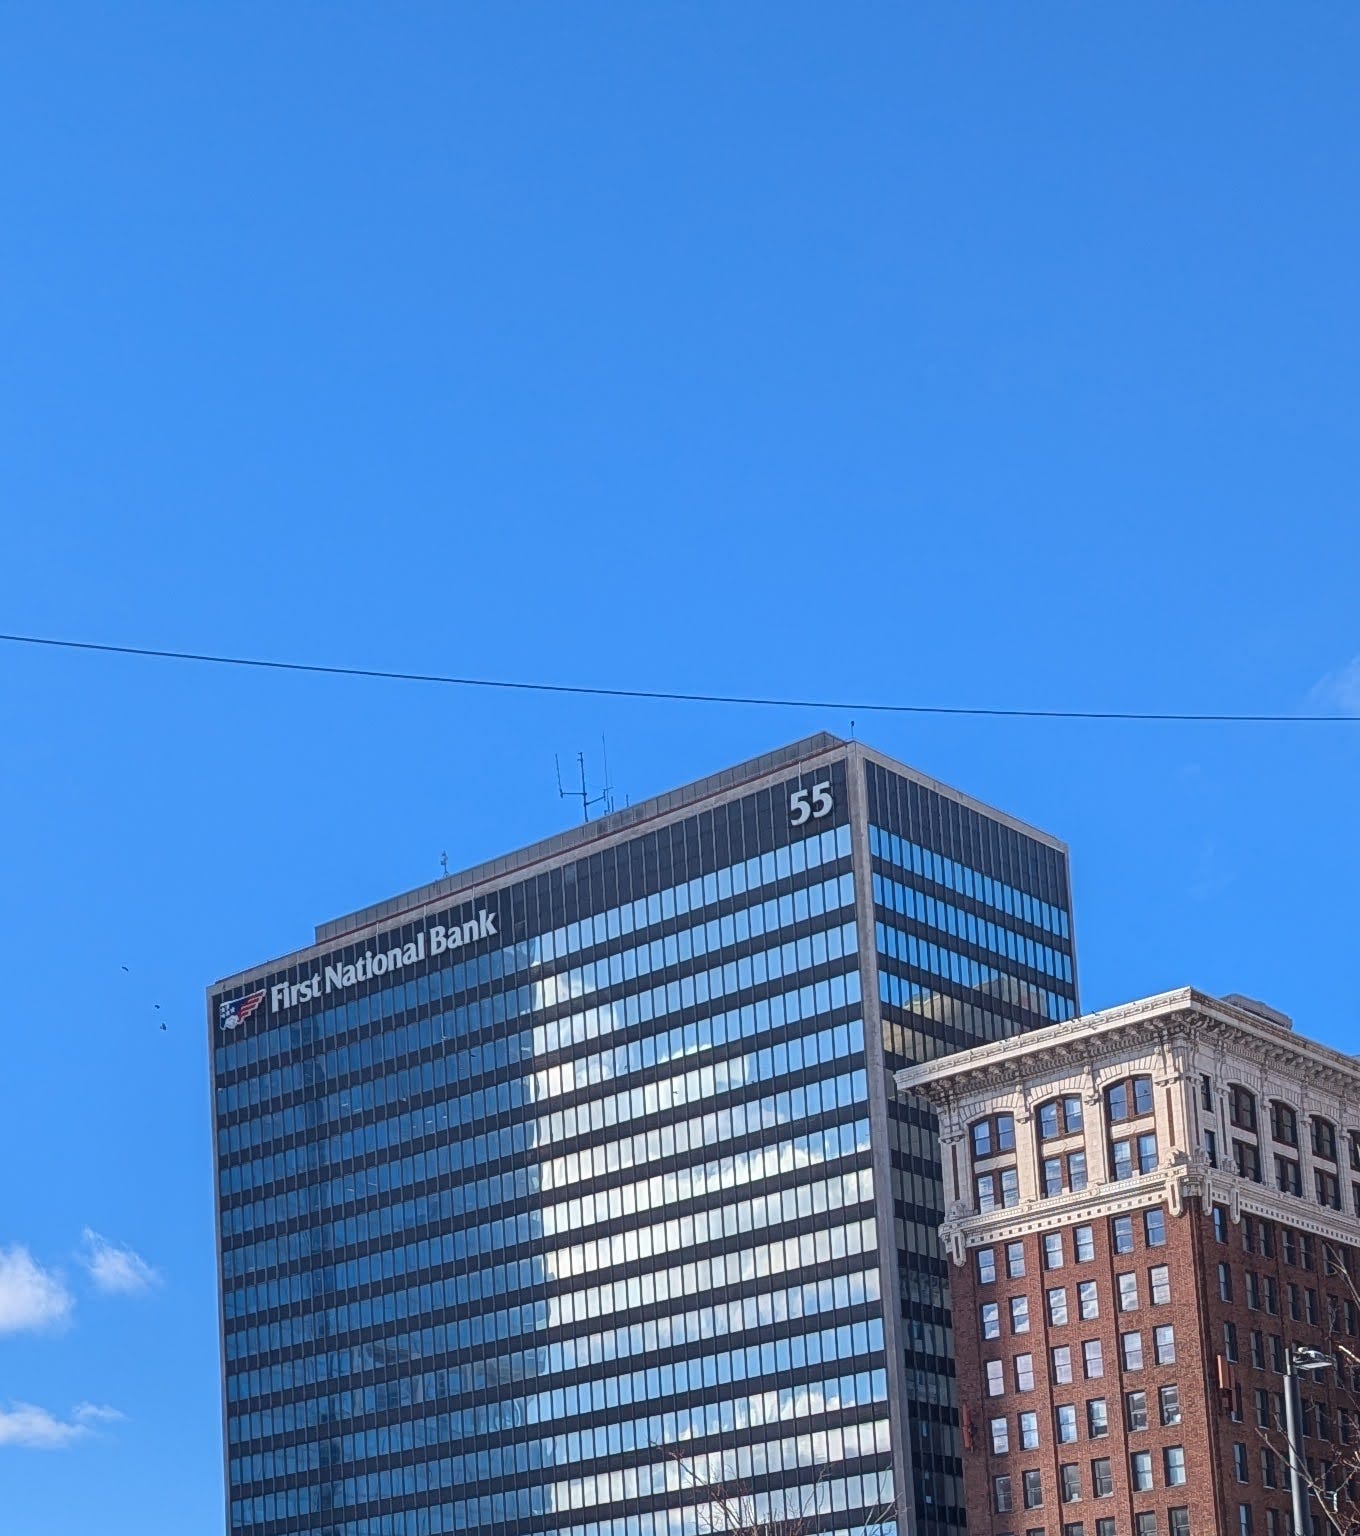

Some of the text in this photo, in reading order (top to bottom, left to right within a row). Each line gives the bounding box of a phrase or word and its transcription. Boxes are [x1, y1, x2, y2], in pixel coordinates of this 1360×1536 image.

[791, 781, 833, 826] 55
[271, 909, 497, 1013] First National Bank
